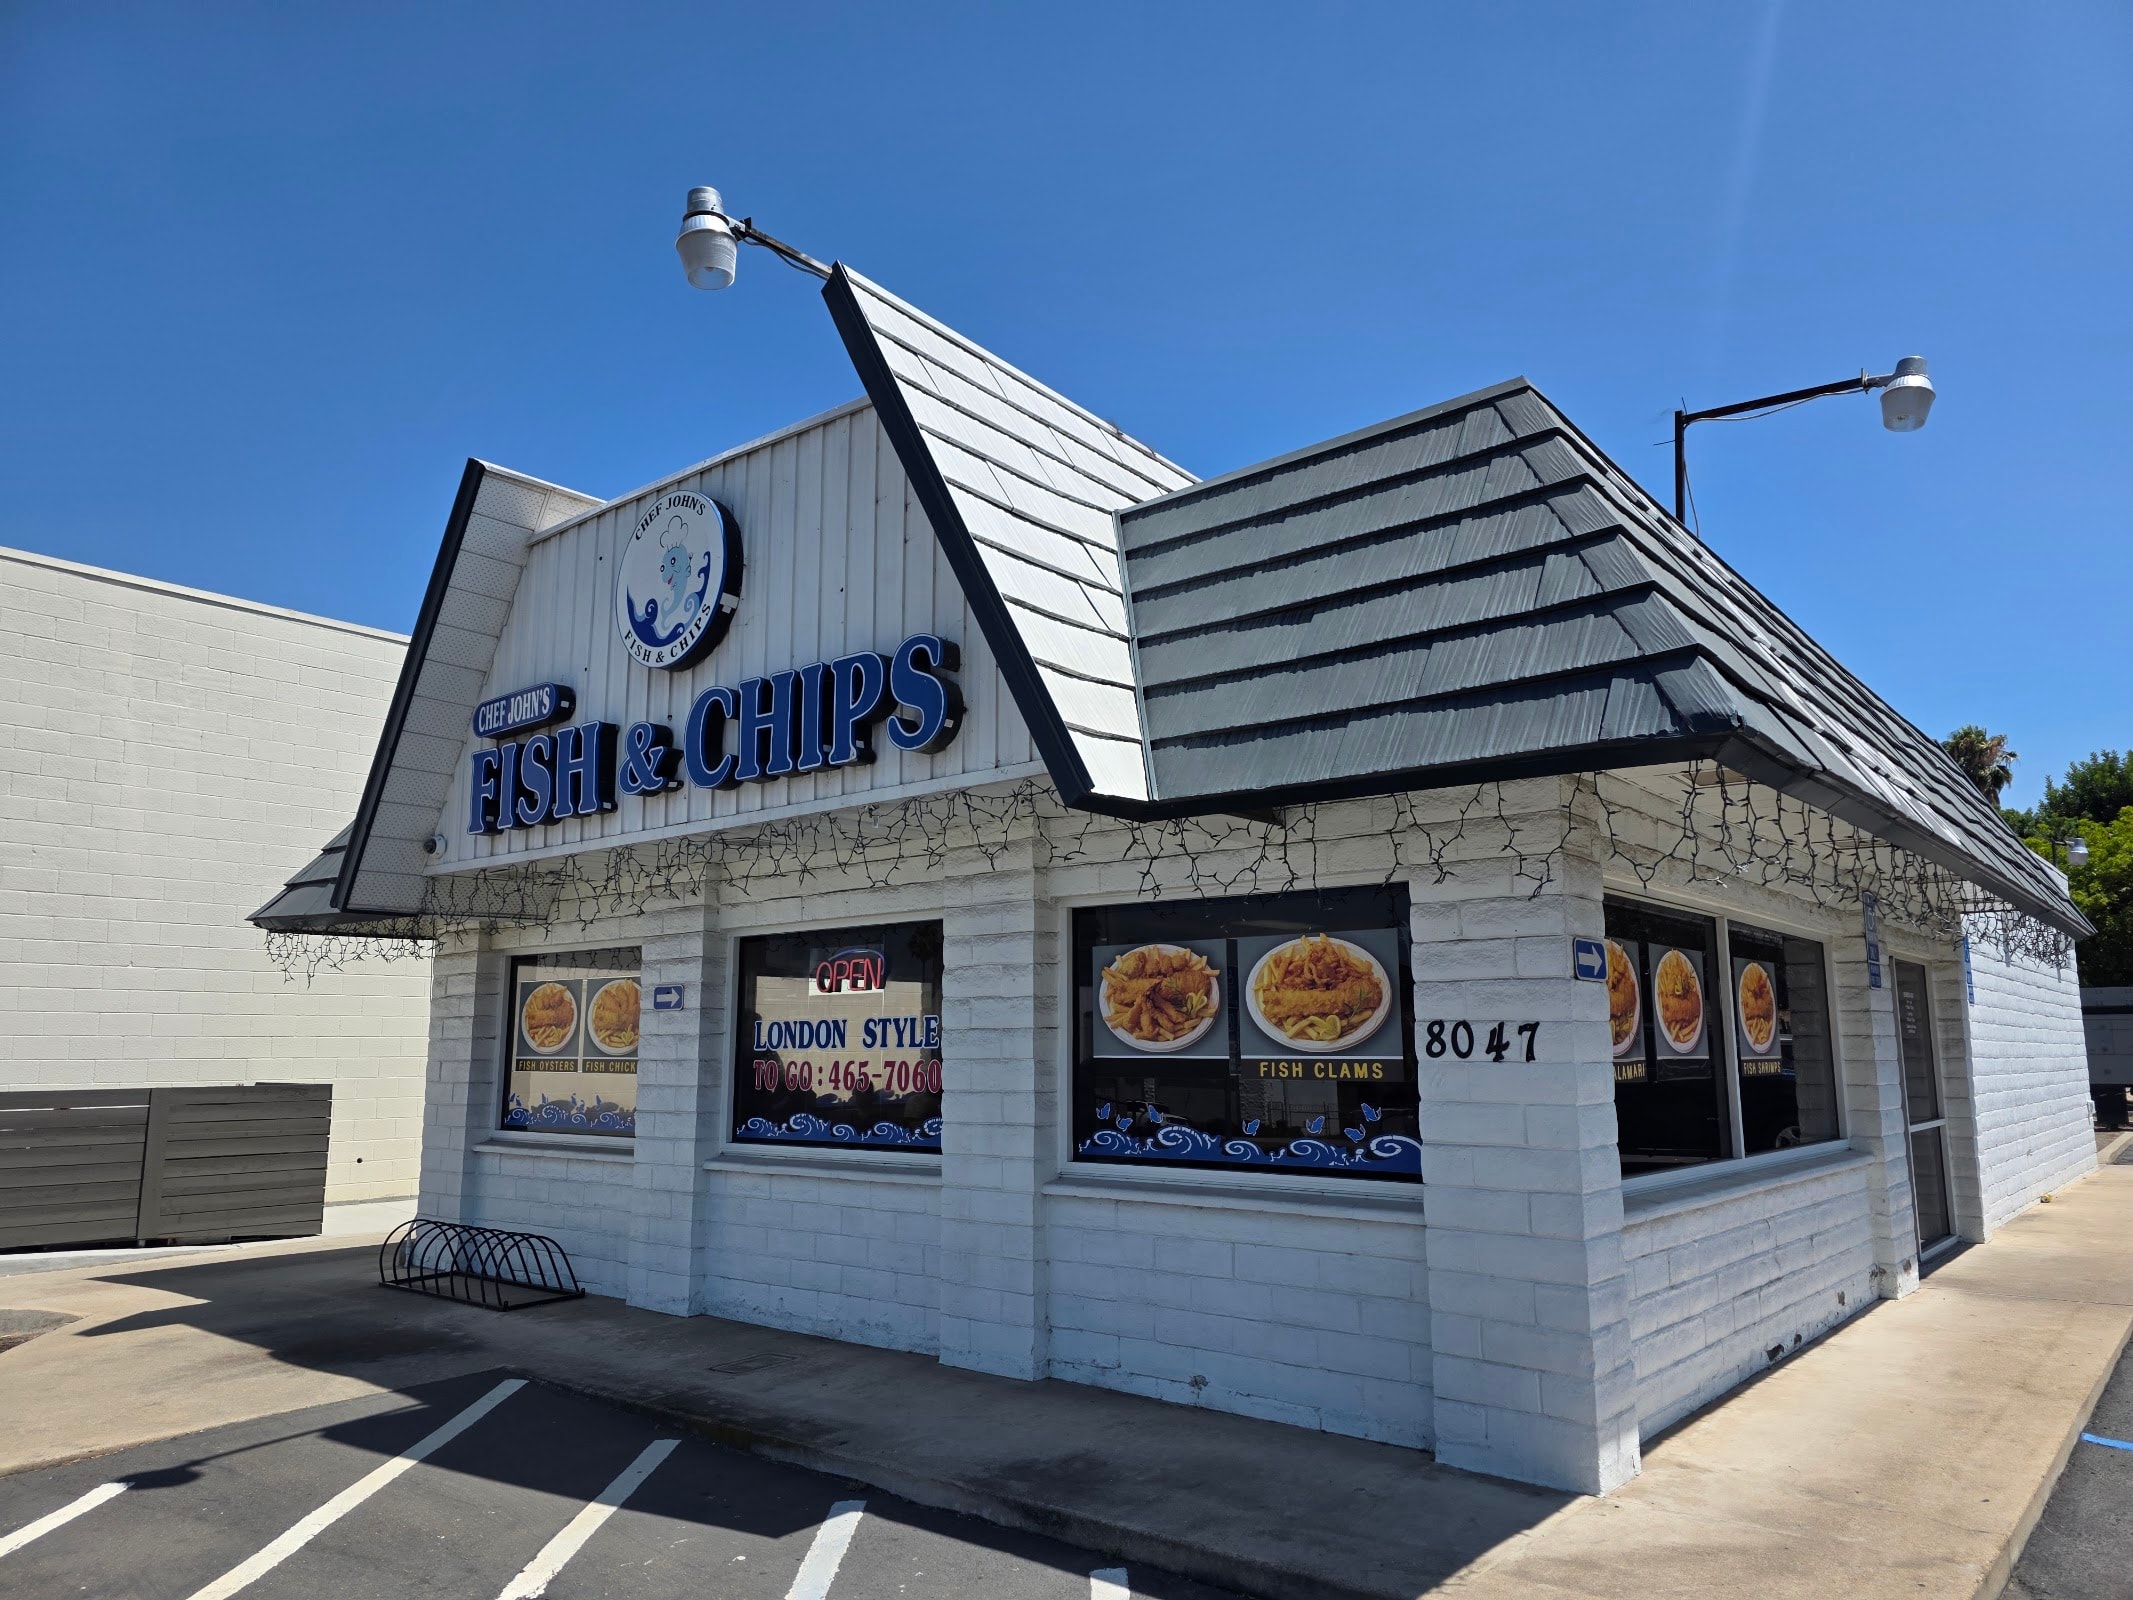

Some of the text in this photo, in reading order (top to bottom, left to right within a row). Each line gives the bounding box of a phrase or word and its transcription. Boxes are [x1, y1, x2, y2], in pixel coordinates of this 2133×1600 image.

[635, 495, 706, 541] CHEF JOHN'S
[624, 603, 711, 663] FISH & CHIPS
[478, 687, 550, 733] CHEF JOHN'S
[467, 633, 949, 835] FISH & CHIPS
[816, 957, 883, 993] OPEN
[754, 1015, 940, 1051] LONDON STYLE
[1425, 1020, 1540, 1062] 8047
[519, 1060, 575, 1072] FISH OYSTERS
[585, 1061, 605, 1072] FISH
[753, 1060, 778, 1092] TO
[1259, 1061, 1384, 1079] FISH CLAMS
[1743, 1061, 1781, 1075] FISH SHRIMPS
